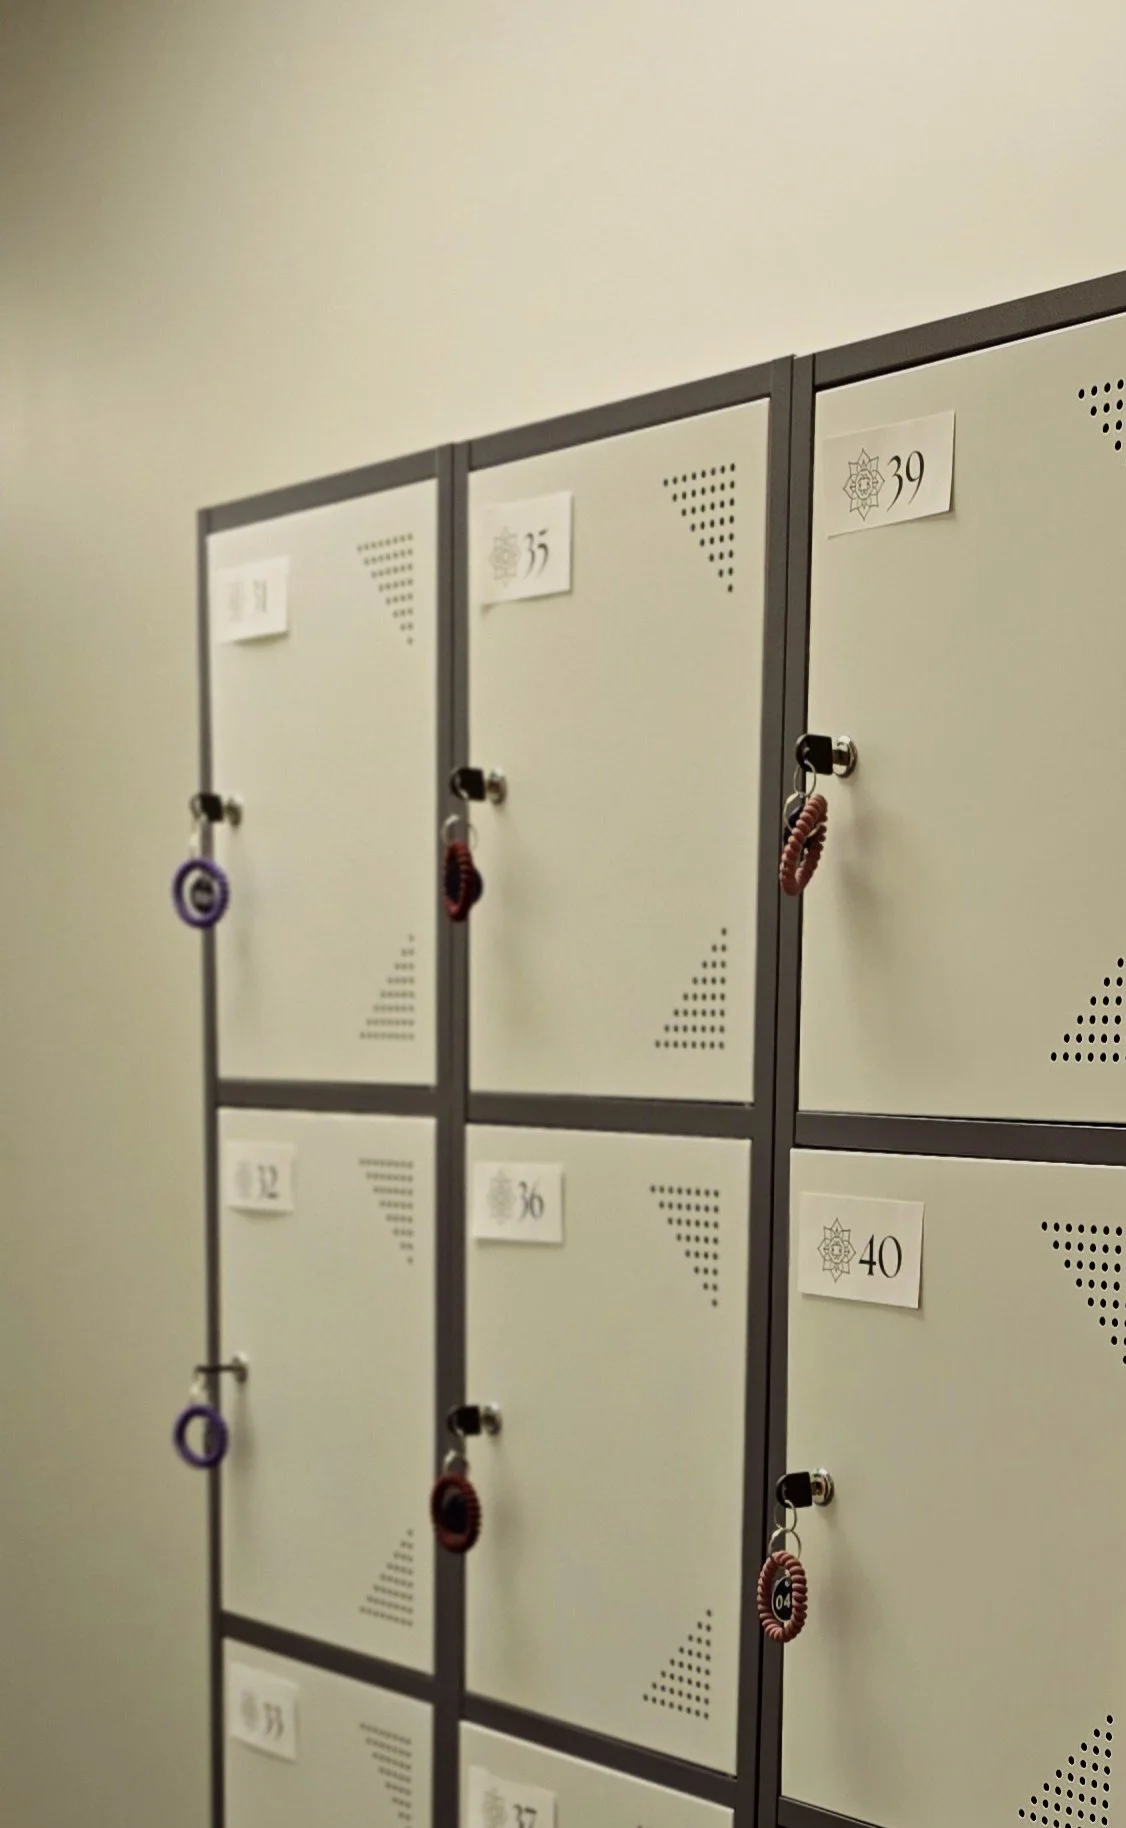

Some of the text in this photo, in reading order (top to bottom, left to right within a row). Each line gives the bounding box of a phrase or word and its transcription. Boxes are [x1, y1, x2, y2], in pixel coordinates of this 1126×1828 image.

[886, 450, 925, 512] 39
[524, 529, 549, 579] 35
[257, 1164, 280, 1201] 32
[519, 1181, 545, 1220] 36
[858, 1234, 903, 1279] 40
[775, 1593, 792, 1610] 04
